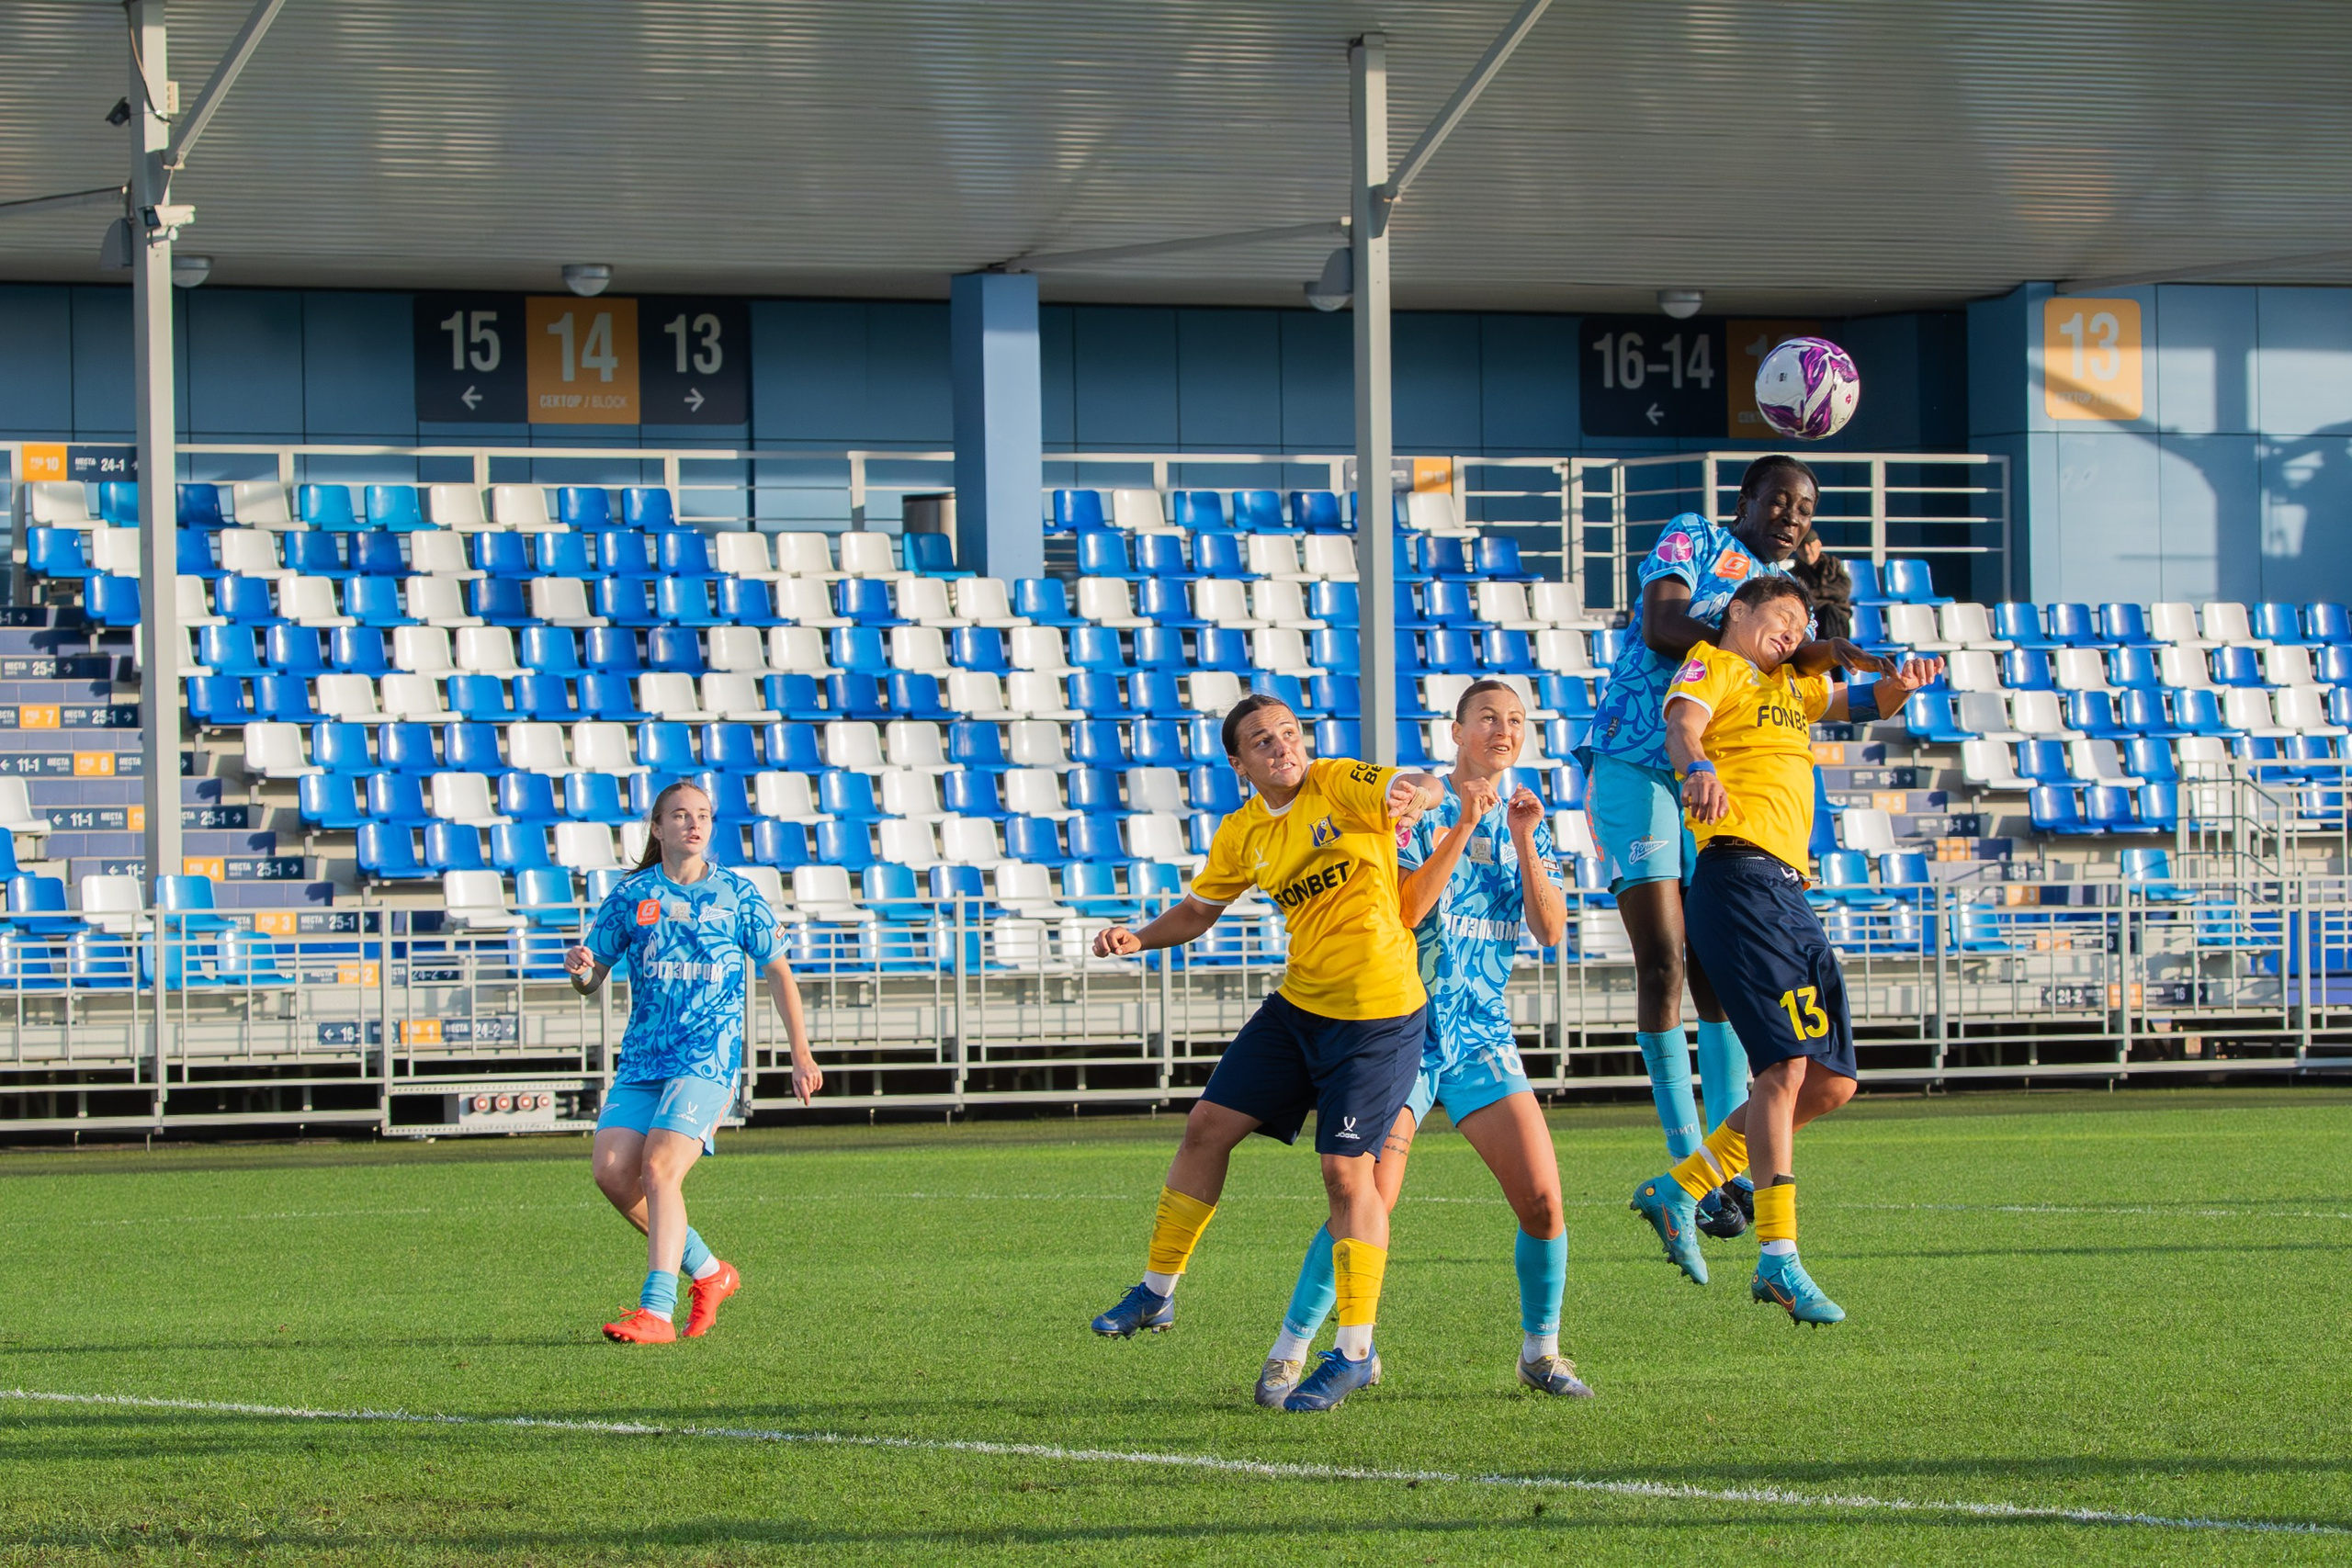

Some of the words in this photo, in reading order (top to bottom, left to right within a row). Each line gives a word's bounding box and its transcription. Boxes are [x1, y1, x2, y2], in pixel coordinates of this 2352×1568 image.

[441, 310, 501, 372] 15
[547, 311, 618, 382] 14
[664, 313, 723, 375] 13
[2059, 311, 2120, 381] 13
[592, 395, 627, 409] BLOCK
[46, 457, 60, 470] 10
[101, 457, 125, 472] 24-1
[32, 660, 56, 676] 25-1
[46, 709, 54, 725] 7
[92, 709, 116, 724] 25-1
[1757, 705, 1810, 739] FONBE
[17, 758, 40, 773] 11-1
[1350, 763, 1370, 783] FO
[69, 812, 93, 827] 11-1
[200, 811, 226, 827] 25-1
[209, 862, 219, 877] 4
[256, 861, 283, 877] 25-1
[1273, 860, 1351, 909] FONBET
[281, 915, 291, 931] 3
[329, 914, 355, 930] 25-1
[1451, 915, 1521, 942] ГАЗПРОМ
[364, 967, 373, 983] 2
[658, 961, 723, 983] ГАЗПРОМ
[2174, 987, 2186, 1000] 16
[1780, 986, 1830, 1041] 13
[340, 1025, 362, 1042] 16-
[427, 1024, 435, 1040] 1
[474, 1022, 501, 1038] 24-2
[1477, 1043, 1523, 1083] 18
